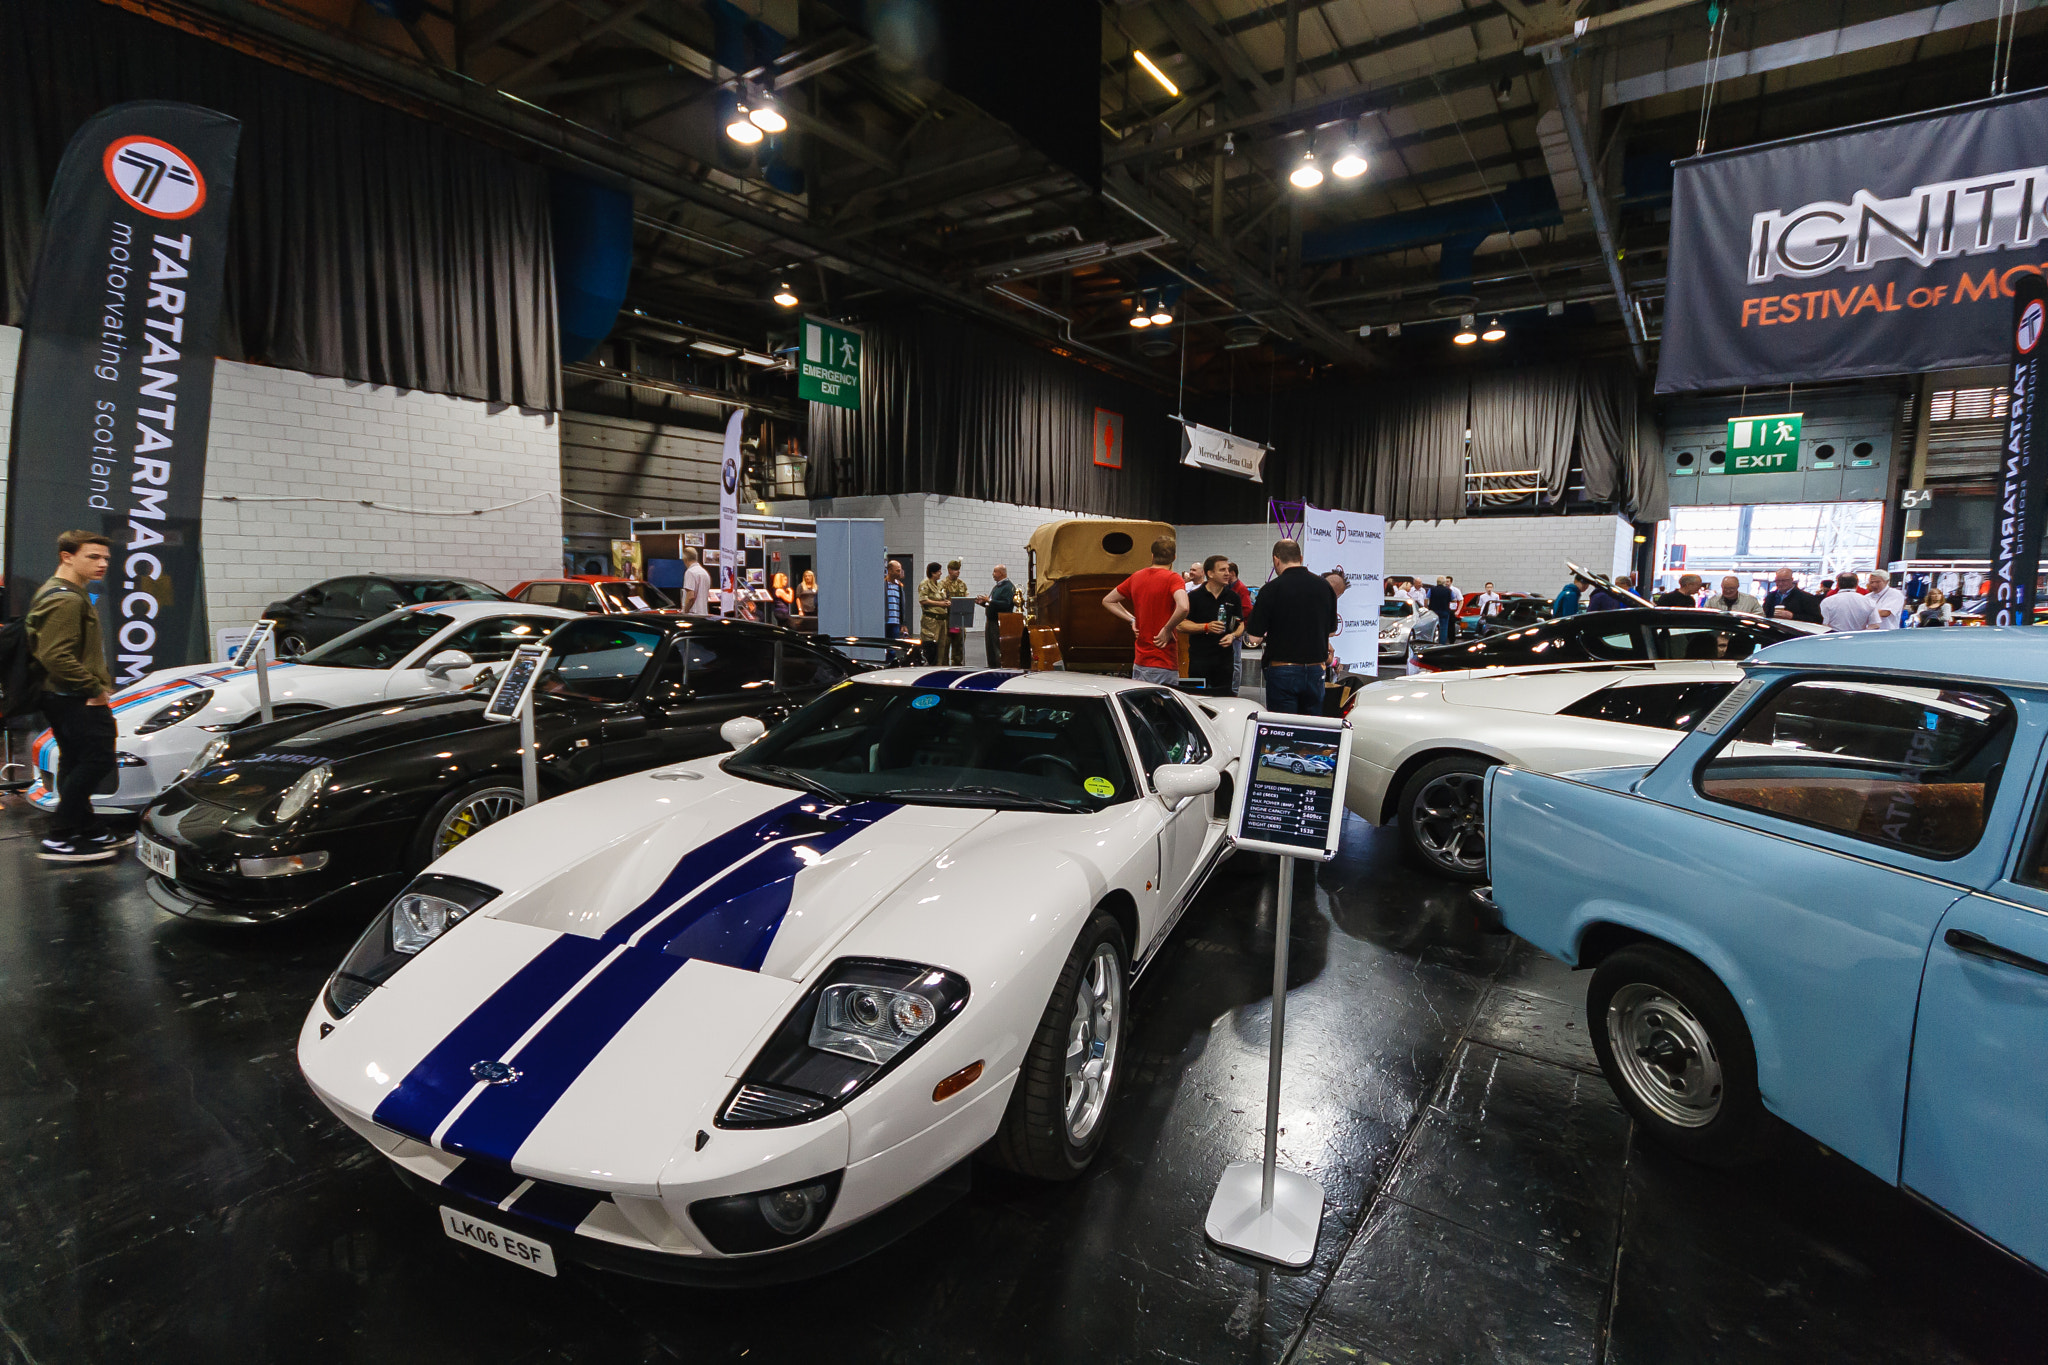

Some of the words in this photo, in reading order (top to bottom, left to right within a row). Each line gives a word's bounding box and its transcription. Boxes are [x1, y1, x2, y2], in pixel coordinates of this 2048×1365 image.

[95, 221, 133, 382] motorvating
[1741, 281, 1902, 327] FESTIVAL
[1907, 285, 1948, 308] OF
[1952, 261, 2048, 305] MO
[803, 363, 857, 386] EMERGENCY
[822, 382, 840, 396] EXIT
[88, 400, 119, 511] scotland
[1223, 438, 1234, 450] The
[115, 234, 191, 685] TARTANTARMAC.COM
[1198, 445, 1240, 466] Mercedes-Benz
[1241, 458, 1253, 470] Club
[1735, 454, 1788, 468] EXIT
[1313, 528, 1332, 537] TARMAC
[1348, 530, 1364, 538] TARTAN
[1364, 530, 1381, 539] TARMAC
[1360, 619, 1378, 627] TARMAC
[450, 1216, 498, 1248] LK06
[504, 1236, 542, 1264] ESF
